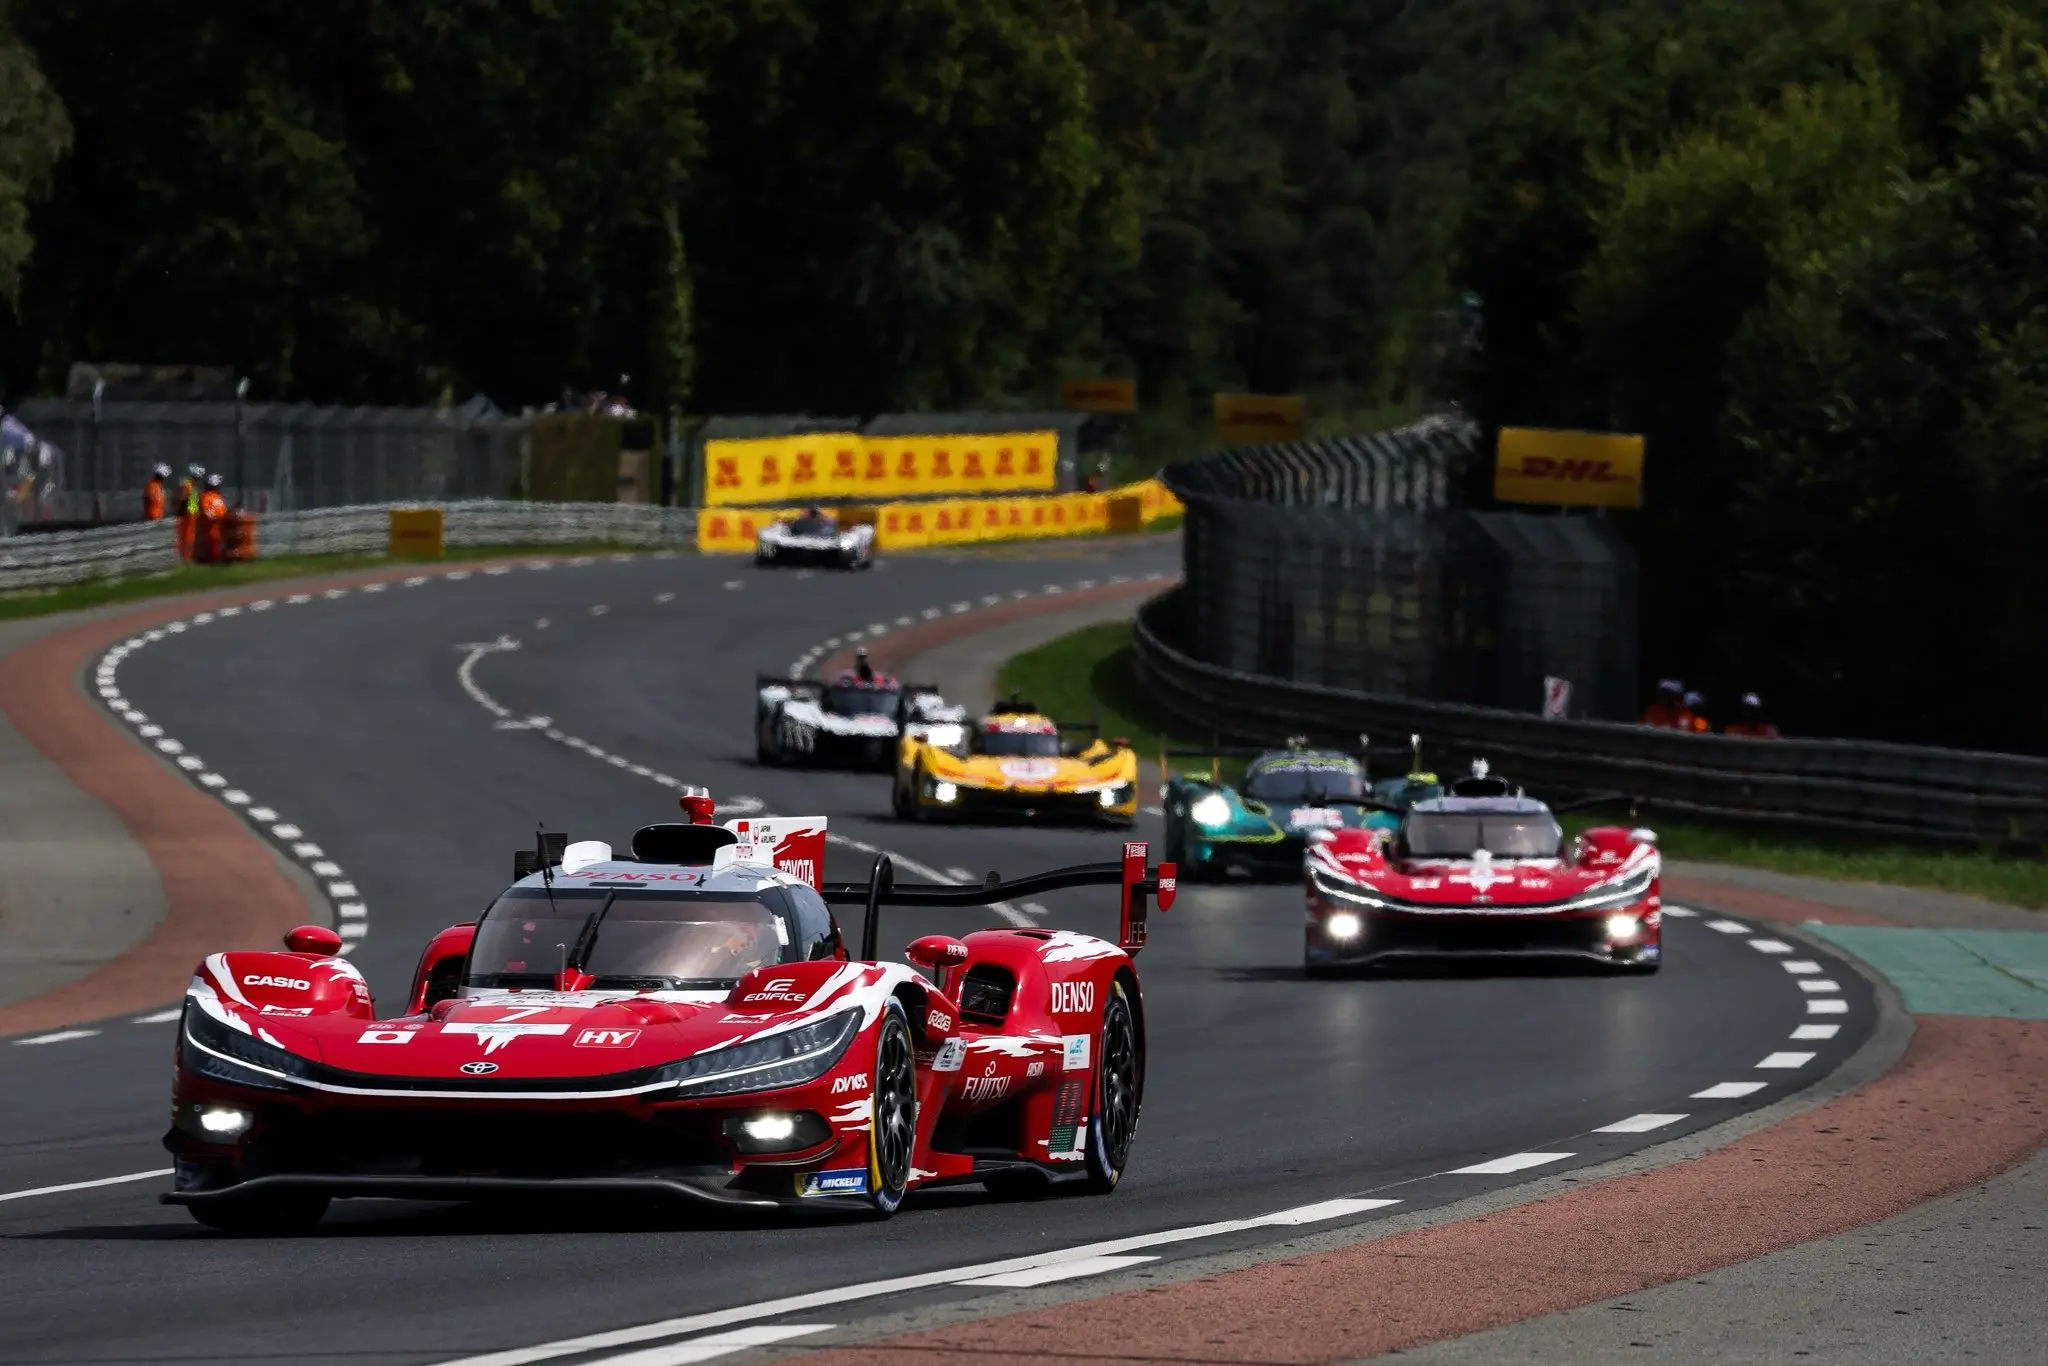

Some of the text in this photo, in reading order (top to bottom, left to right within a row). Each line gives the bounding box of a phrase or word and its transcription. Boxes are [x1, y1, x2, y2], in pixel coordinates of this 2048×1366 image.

[560, 871, 697, 881] DENSO
[243, 975, 311, 991] CASIO
[743, 992, 807, 1002] EDIFICE
[1051, 981, 1094, 1013] DENSO
[493, 1006, 552, 1023] 7
[579, 1031, 635, 1045] HY
[831, 1073, 868, 1094] ADVICS
[961, 1076, 1011, 1105] FUJITSU
[820, 1177, 863, 1189] MICHELIN
